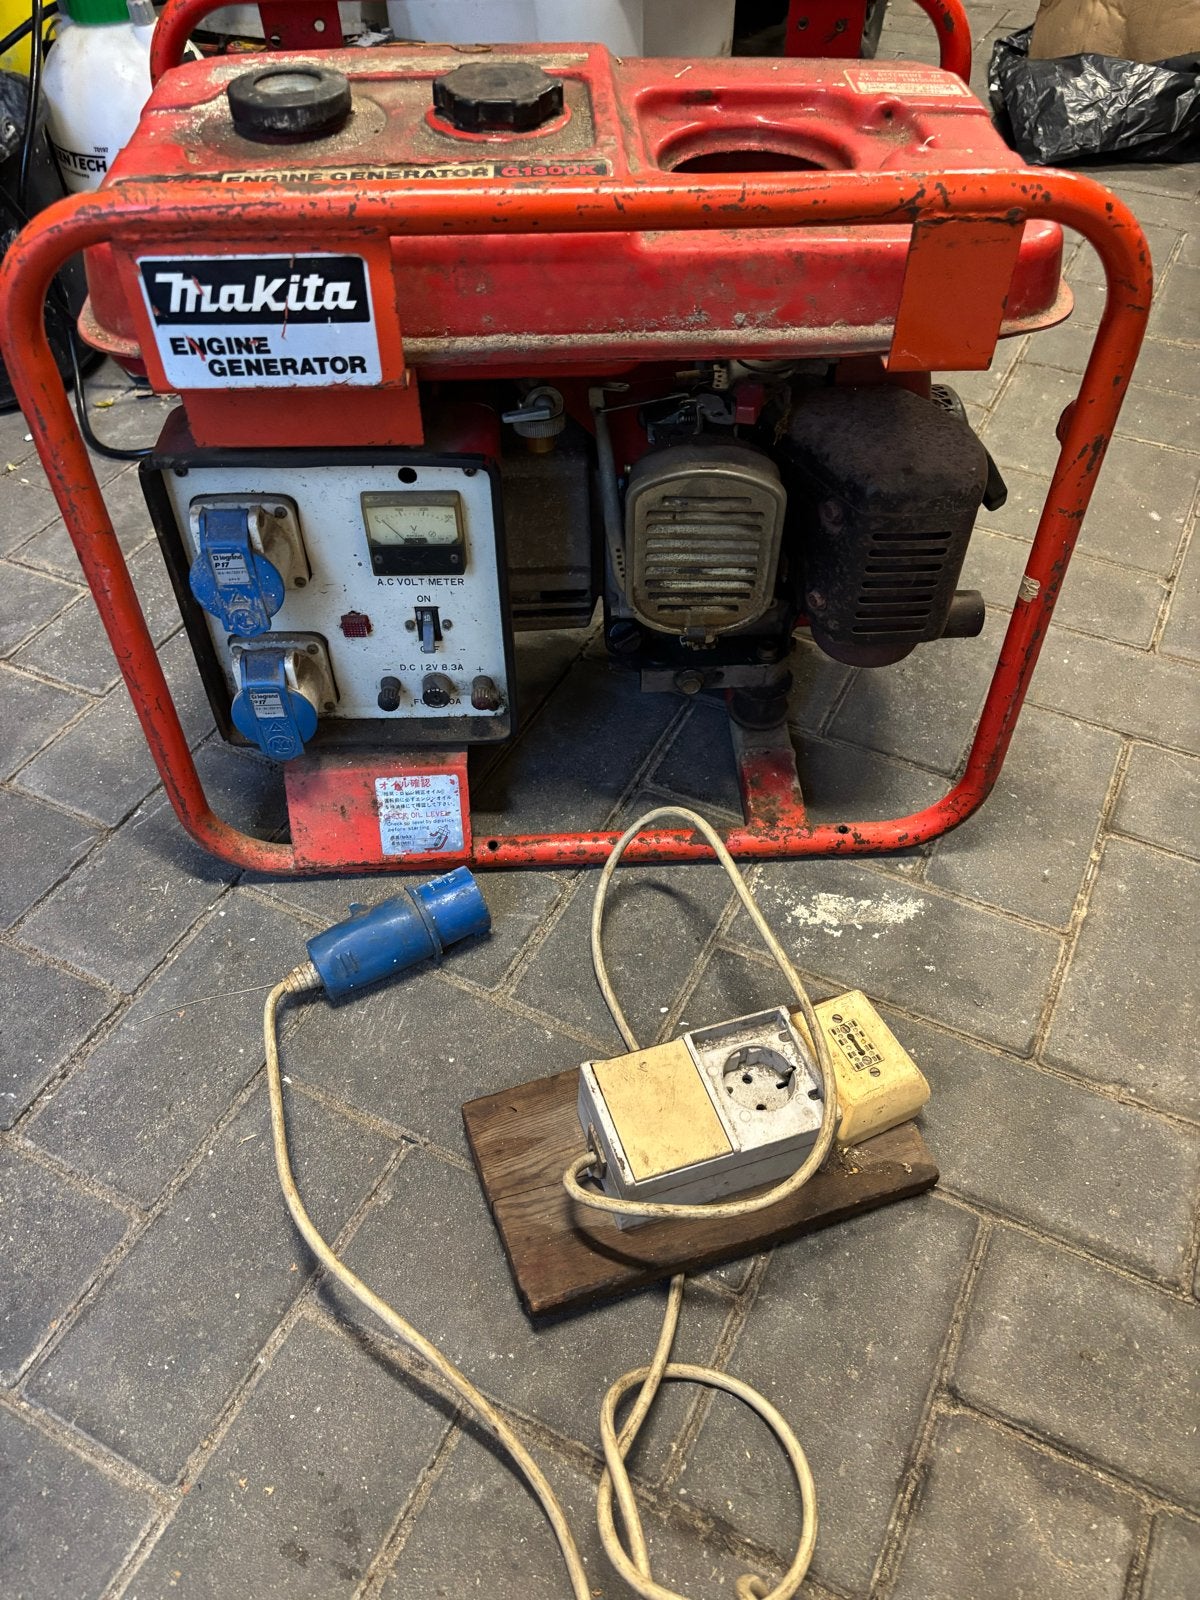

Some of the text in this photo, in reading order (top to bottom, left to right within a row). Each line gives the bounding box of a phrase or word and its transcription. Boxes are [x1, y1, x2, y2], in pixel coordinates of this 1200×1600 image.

[226, 172, 323, 183] ENGINE
[330, 167, 489, 181] GENERATOR
[169, 337, 271, 356] ENGINE
[208, 356, 367, 377] GENERATOR
[377, 578, 465, 586] A.C VOLT METER
[417, 595, 431, 603] ON
[411, 811, 423, 819] OIL
